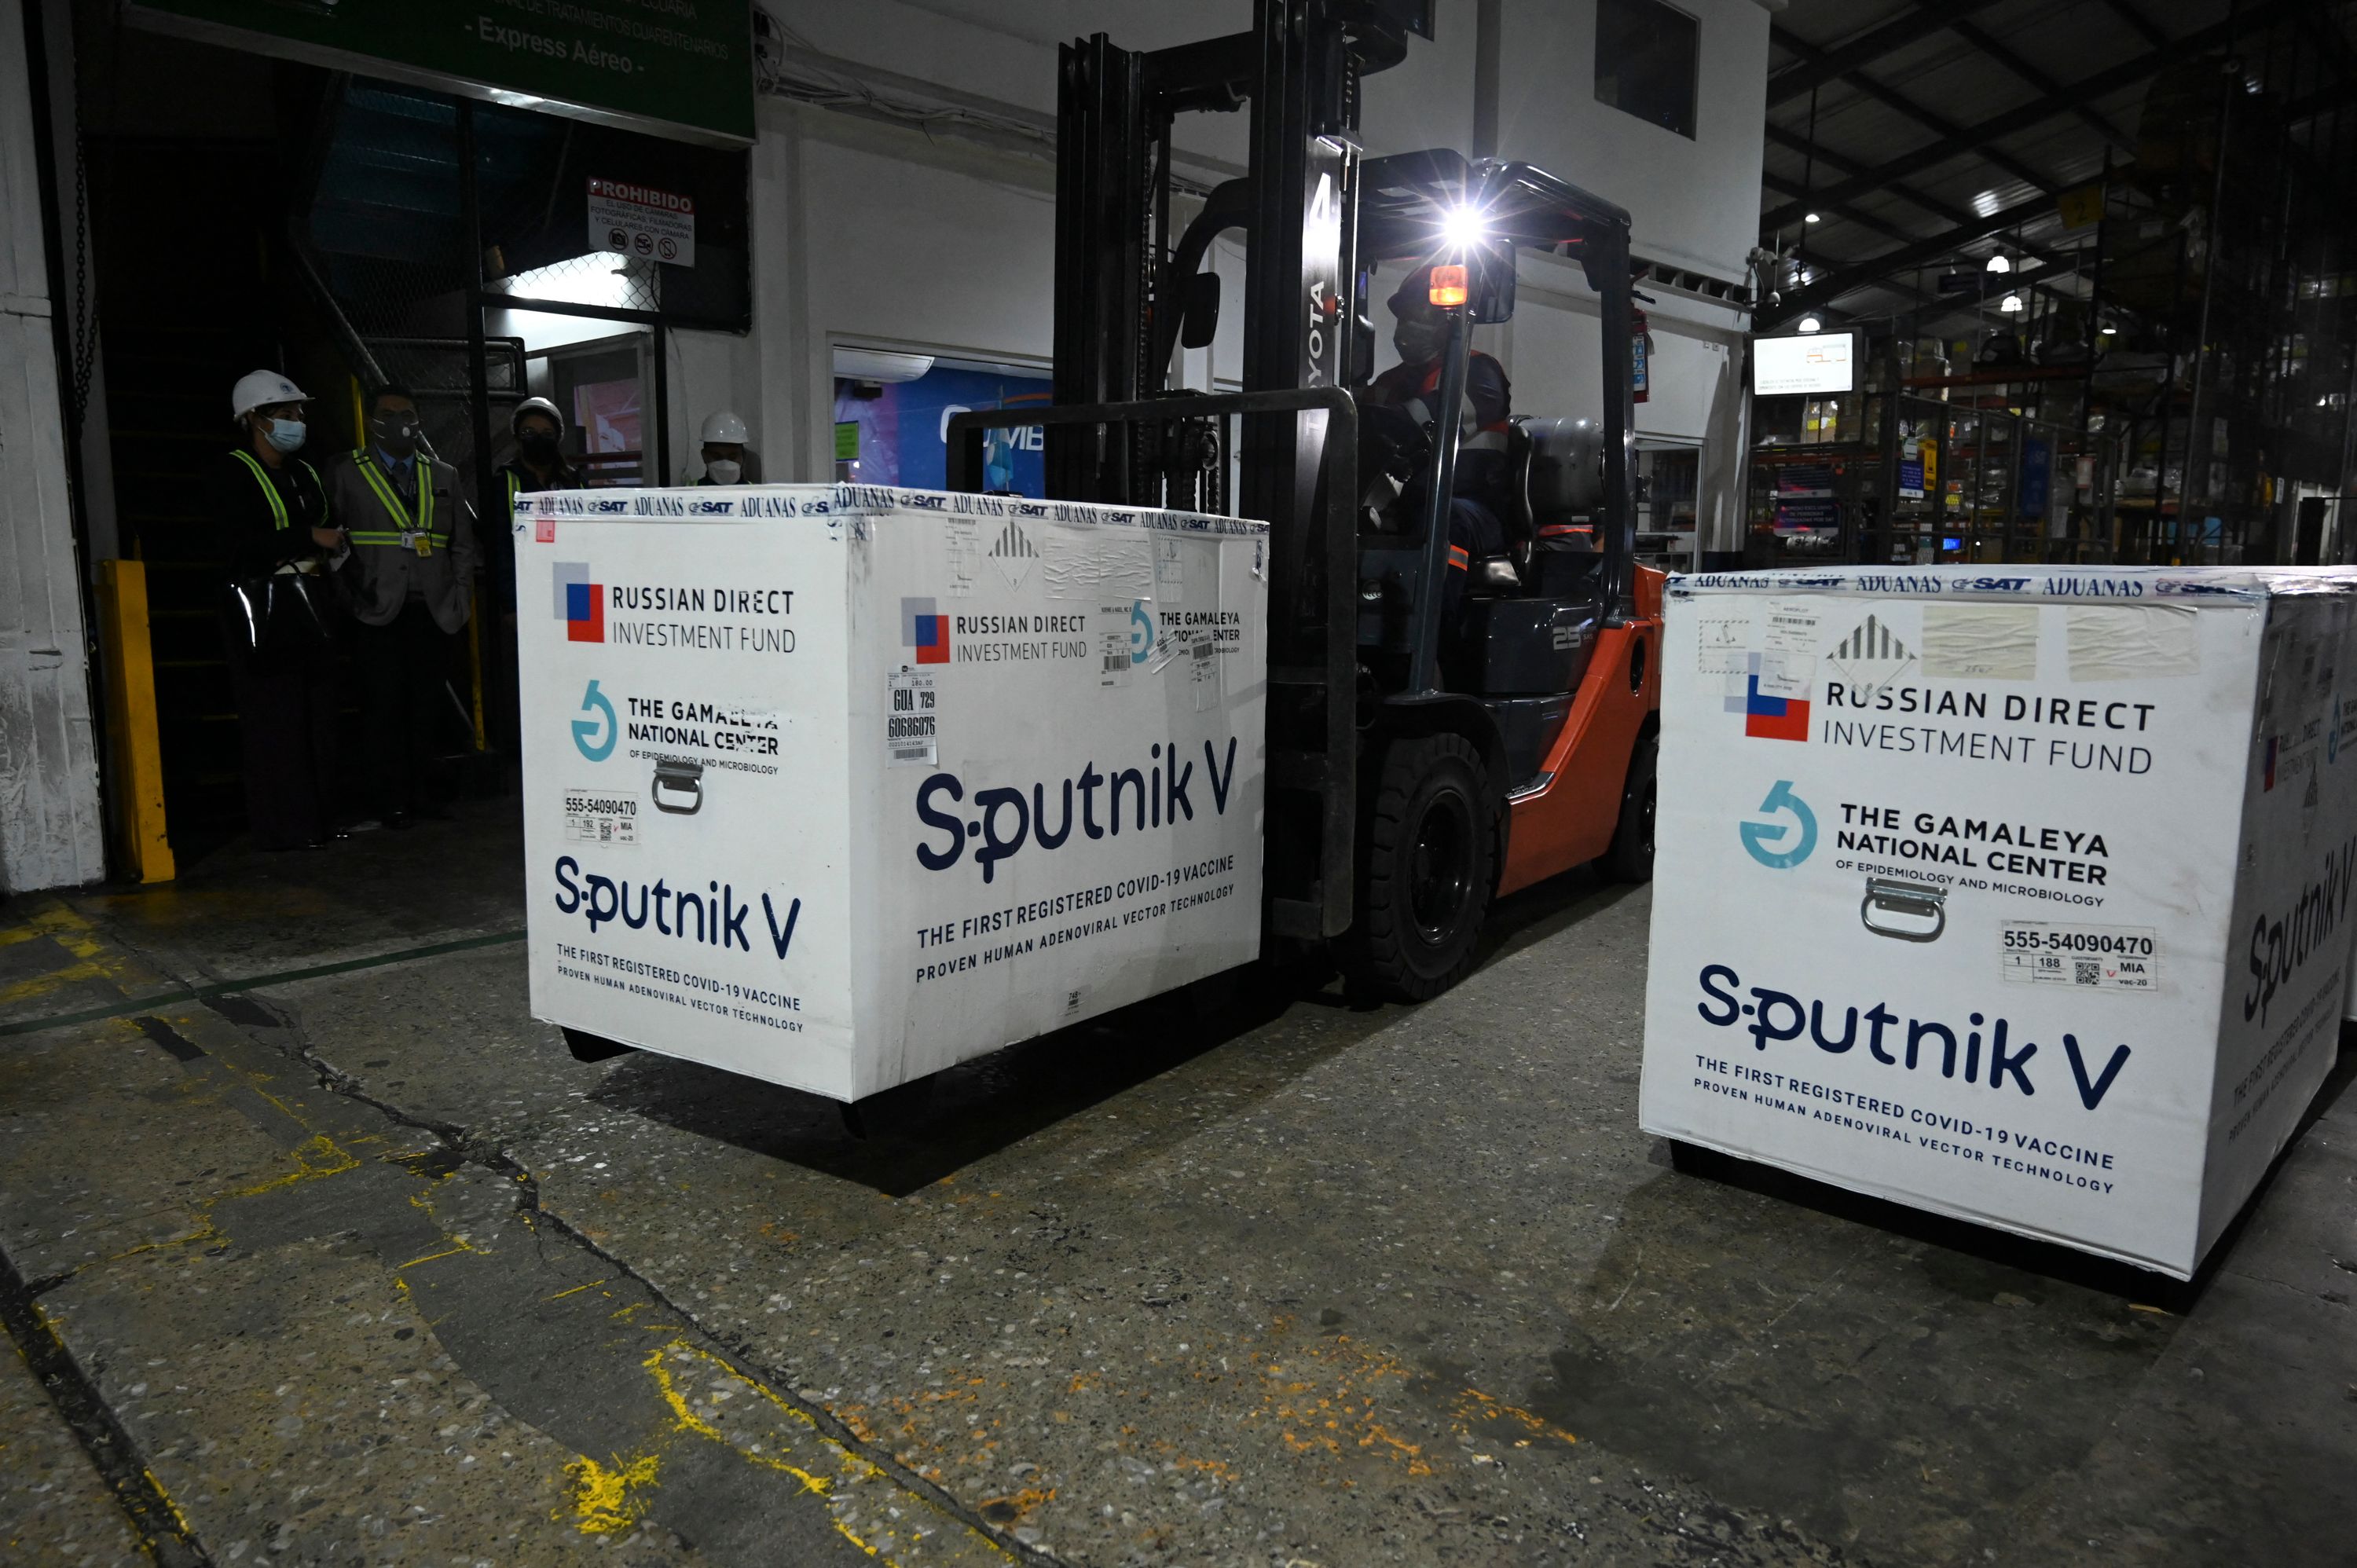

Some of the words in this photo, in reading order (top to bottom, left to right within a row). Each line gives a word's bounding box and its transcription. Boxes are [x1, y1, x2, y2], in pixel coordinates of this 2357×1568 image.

[478, 16, 567, 59] Express
[572, 39, 633, 74] Aéreo
[548, 2, 631, 36] TRATAMIENTOS
[632, 22, 729, 60] CUARENTENARIOS
[590, 179, 692, 212] PROHIBIDO
[617, 201, 631, 210] USO
[601, 218, 643, 232] CELULARES
[644, 225, 659, 234] CON
[649, 217, 692, 232] FILMADORAS
[539, 496, 584, 515] ADUANAS
[599, 501, 628, 511] SAT
[634, 496, 683, 516] ADUANAS
[701, 501, 733, 512] SAT
[741, 496, 795, 517] ADUANAS
[834, 486, 894, 510] ADUANAS
[913, 495, 947, 510] SAT
[953, 494, 1003, 517] ADUANAS
[1019, 504, 1049, 517] SAT
[1054, 505, 1098, 524] ADUANAS
[1110, 511, 1135, 523] SAT
[1140, 511, 1178, 530] ADUANAS
[1188, 519, 1210, 530] SAT
[1215, 518, 1247, 535] ADUANAS
[1256, 524, 1269, 533] SA
[613, 586, 706, 612] RUSSIAN
[713, 589, 794, 615] DIRECT
[1695, 576, 1769, 588] ADUANAS
[1856, 575, 1941, 593] ADUANAS
[1973, 577, 2032, 590] SAT
[2042, 577, 2143, 597] ADUANAS
[956, 616, 1028, 634] RUSSIAN
[1034, 616, 1086, 632] DIRECT
[1160, 612, 1181, 625] THE
[1185, 612, 1240, 625] GAMALEYA
[613, 621, 733, 650] INVESTMENT
[740, 628, 796, 653] FUND
[1213, 629, 1240, 641] ENTER
[1552, 625, 1582, 650] 25
[957, 641, 1048, 662] INVESTMENT
[1052, 641, 1087, 658] FUND
[628, 697, 663, 719] THE
[893, 689, 914, 711] GUA
[920, 691, 935, 709] 729
[1827, 682, 1987, 719] RUSSIAN
[2004, 694, 2155, 731] DIRECT
[629, 723, 709, 748] NATIONAL
[889, 716, 935, 738] 60686076
[629, 749, 640, 758] OF
[642, 750, 698, 765] EPIDEMIOLOGY
[701, 757, 717, 768] AND
[719, 760, 779, 775] MICROBIOLOGY
[1824, 720, 2036, 763] INVESTMENT
[2049, 740, 2153, 775] FUND
[566, 797, 636, 815] 555-54090470
[916, 742, 1193, 885] Sputnik
[1204, 736, 1237, 815] V
[1841, 803, 1901, 830] THE
[1914, 812, 2110, 858] GAMALEYA
[1837, 830, 1978, 868] NATIONAL
[1987, 852, 2108, 886] CENTER
[1835, 859, 1853, 870] OF
[1857, 862, 1955, 885] EPIDEMIOLOGY
[1959, 877, 1988, 890] AND
[1992, 882, 2105, 908] MICROBIOLOGY
[555, 855, 750, 952] Sputnik
[761, 892, 801, 960] V
[918, 923, 955, 949] THE
[962, 908, 1014, 939] FIRST
[1017, 885, 1113, 925] REGISTERED
[1116, 868, 1180, 899] COVID-19
[1182, 855, 1234, 882] VACCINE
[915, 953, 977, 984] PROVEN
[984, 938, 1034, 965] HUMAN
[1039, 915, 1119, 950] ADENOVIRAL
[1123, 903, 1167, 927] VECTOR
[1170, 884, 1234, 913] TECHNOLOGY
[2004, 930, 2153, 955] 555-54090470
[2245, 849, 2339, 1030] Sputnik
[557, 943, 577, 959] THE
[580, 948, 610, 967] FIRST
[613, 958, 680, 984] REGISTERED
[684, 974, 740, 998] COVID-19
[742, 987, 801, 1011] VACCINE
[2015, 956, 2021, 965] 1
[2039, 957, 2061, 968] 188
[2121, 962, 2146, 973] MIA
[557, 965, 591, 982] PROVEN
[594, 973, 625, 991] HUMAN
[629, 984, 687, 1006] ADENOVIRAL
[691, 998, 729, 1017] VECTOR
[732, 1008, 804, 1033] TECHNOLOGY
[1698, 964, 2038, 1097] Sputnik
[2063, 1033, 2132, 1111] V
[1695, 1054, 1728, 1075] THE
[1734, 1064, 1785, 1089] FIRST
[1789, 1079, 1904, 1119] REGISTERED
[1911, 1108, 2008, 1145] COVID-19
[2014, 1133, 2115, 1171] VACCINE
[1694, 1078, 1749, 1101] PROVEN
[1754, 1094, 1807, 1116] HUMAN
[1813, 1109, 1912, 1144] ADENOVIRAL
[1919, 1137, 1985, 1163] VECTOR
[1992, 1154, 2115, 1194] TECHNOLOGY
